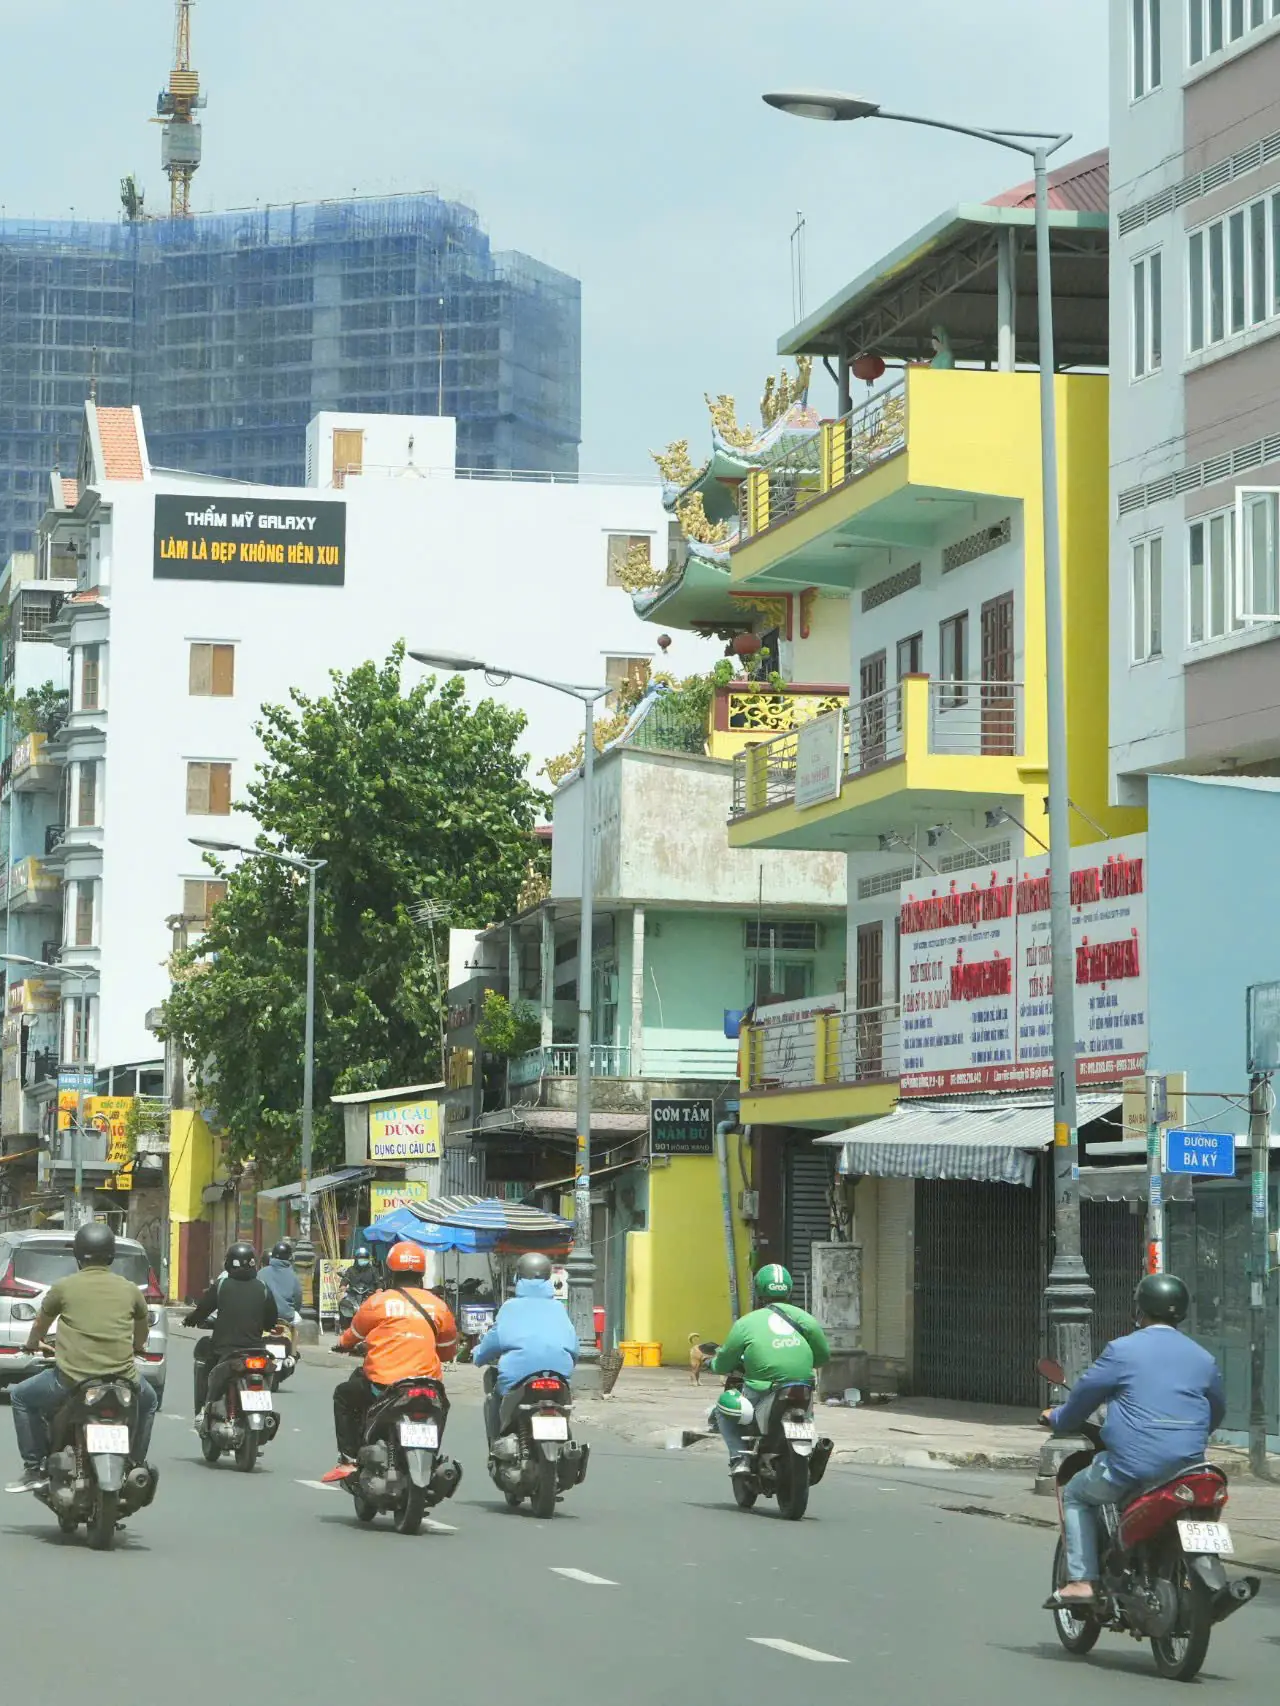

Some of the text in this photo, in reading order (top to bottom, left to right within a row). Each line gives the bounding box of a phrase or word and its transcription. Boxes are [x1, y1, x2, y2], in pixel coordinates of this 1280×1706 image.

[185, 505, 317, 531] THẨM MỸ GALAXY
[160, 536, 339, 565] LÀM LÀ ĐẸP KHÔNG HÊN XUI
[402, 1107, 433, 1120] CÂU
[654, 1101, 710, 1121] CƠM TẤM
[374, 1143, 395, 1157] DỤNG
[397, 1143, 406, 1157] CỤ
[409, 1140, 424, 1154] CÂU
[1183, 1135, 1218, 1148] ĐƯỜNG
[1183, 1150, 1217, 1167] BÀ KÝ
[768, 1283, 788, 1291] Grab
[772, 1334, 801, 1349] Grab
